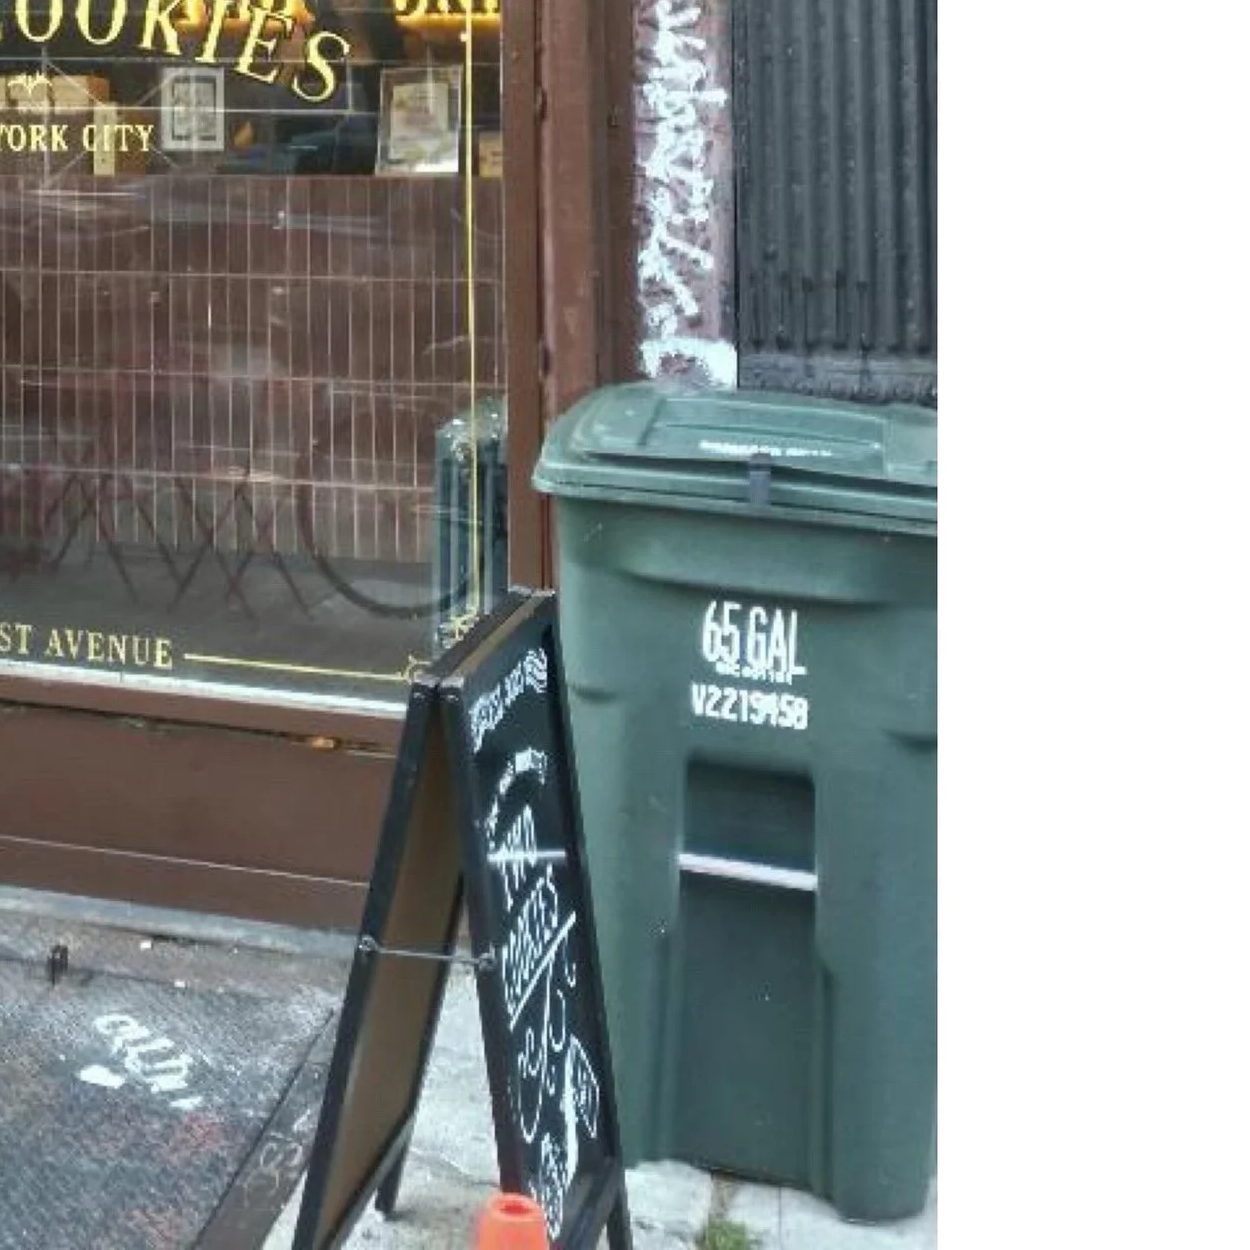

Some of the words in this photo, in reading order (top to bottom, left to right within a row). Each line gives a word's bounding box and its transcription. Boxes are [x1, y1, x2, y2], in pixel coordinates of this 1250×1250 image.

[82, 123, 155, 152] CITY
[46, 627, 174, 670] AVENUE
[747, 605, 808, 676] GAL
